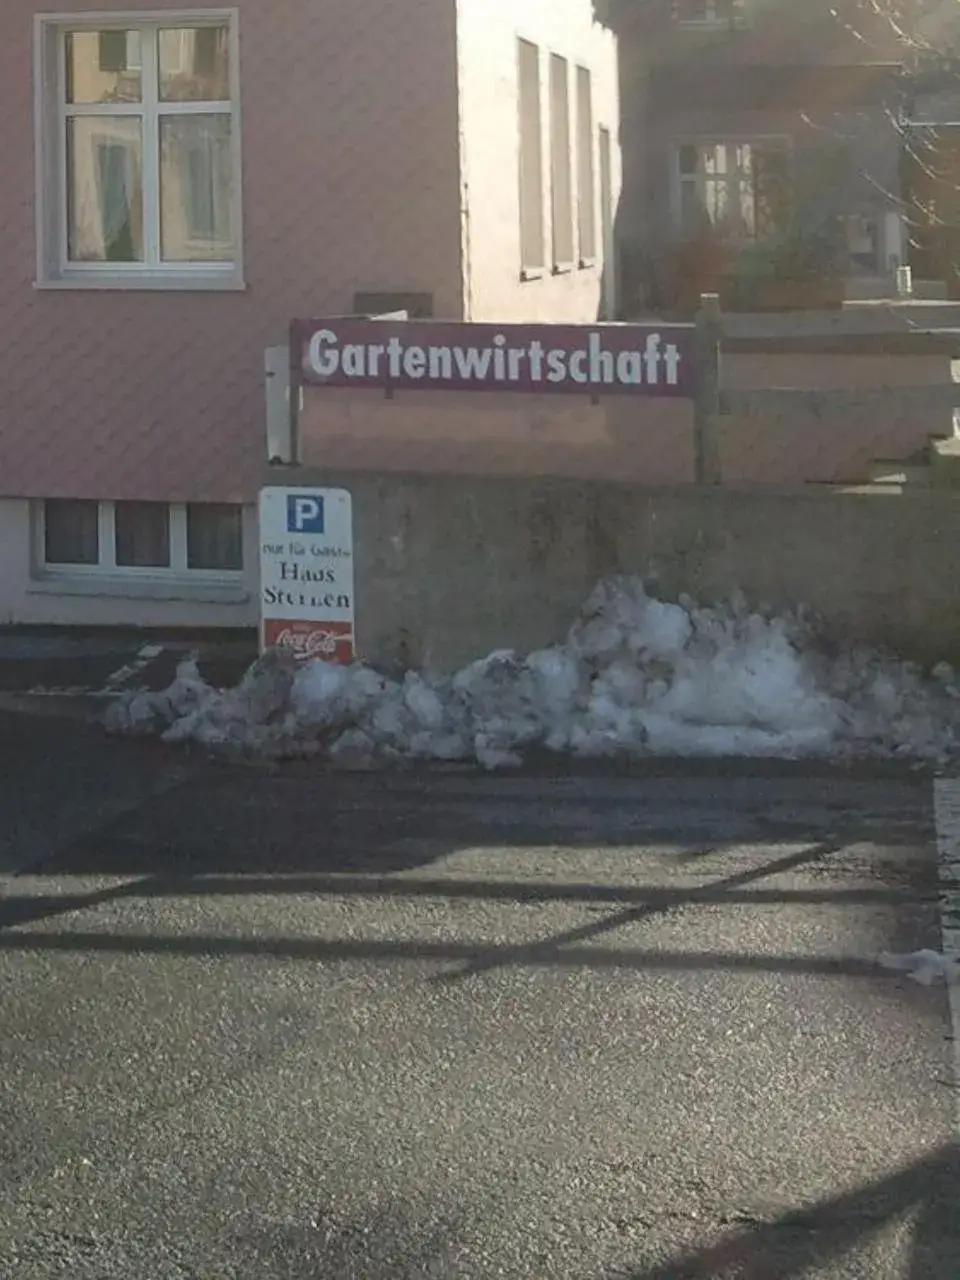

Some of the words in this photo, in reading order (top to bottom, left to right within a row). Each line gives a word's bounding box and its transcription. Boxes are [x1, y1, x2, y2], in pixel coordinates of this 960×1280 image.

[309, 328, 681, 385] Gartenwirtschaft
[295, 498, 319, 530] P
[280, 562, 335, 582] Haus
